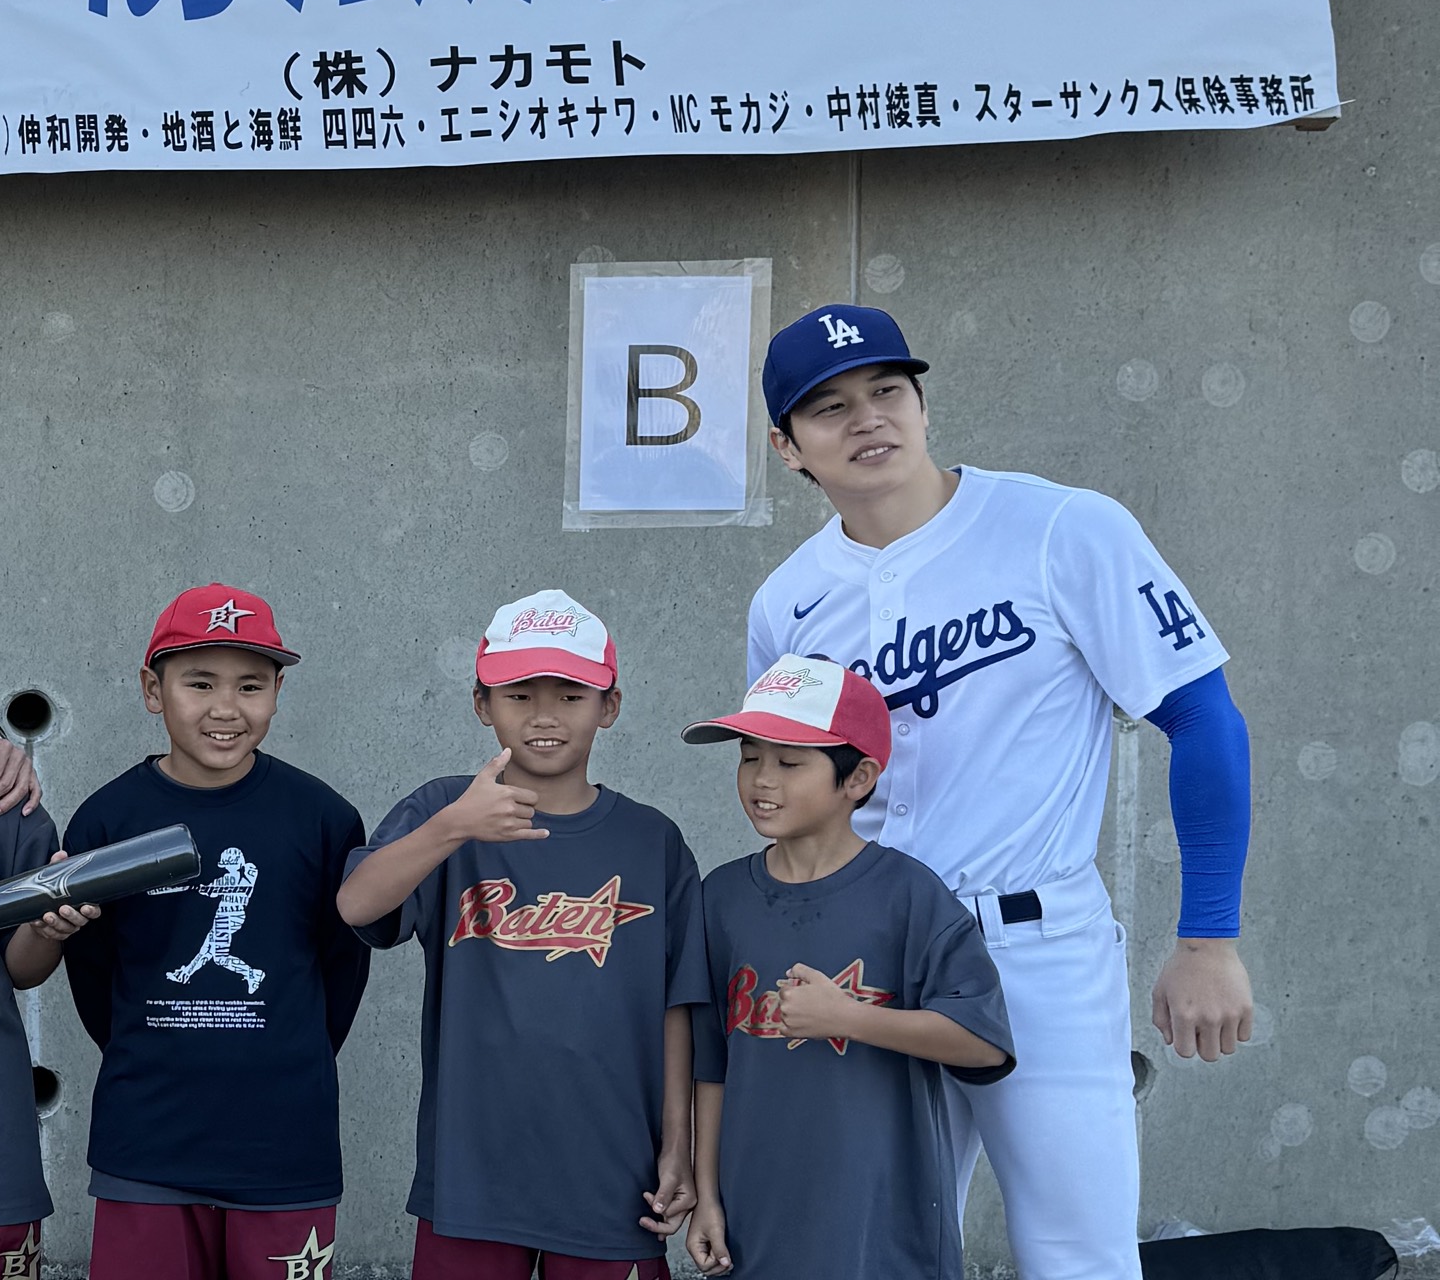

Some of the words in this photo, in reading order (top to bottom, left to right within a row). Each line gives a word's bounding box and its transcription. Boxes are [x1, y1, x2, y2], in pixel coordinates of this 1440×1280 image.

[819, 313, 864, 349] LA
[626, 344, 702, 446] B
[1138, 581, 1206, 650] LA
[449, 877, 618, 949] Baten
